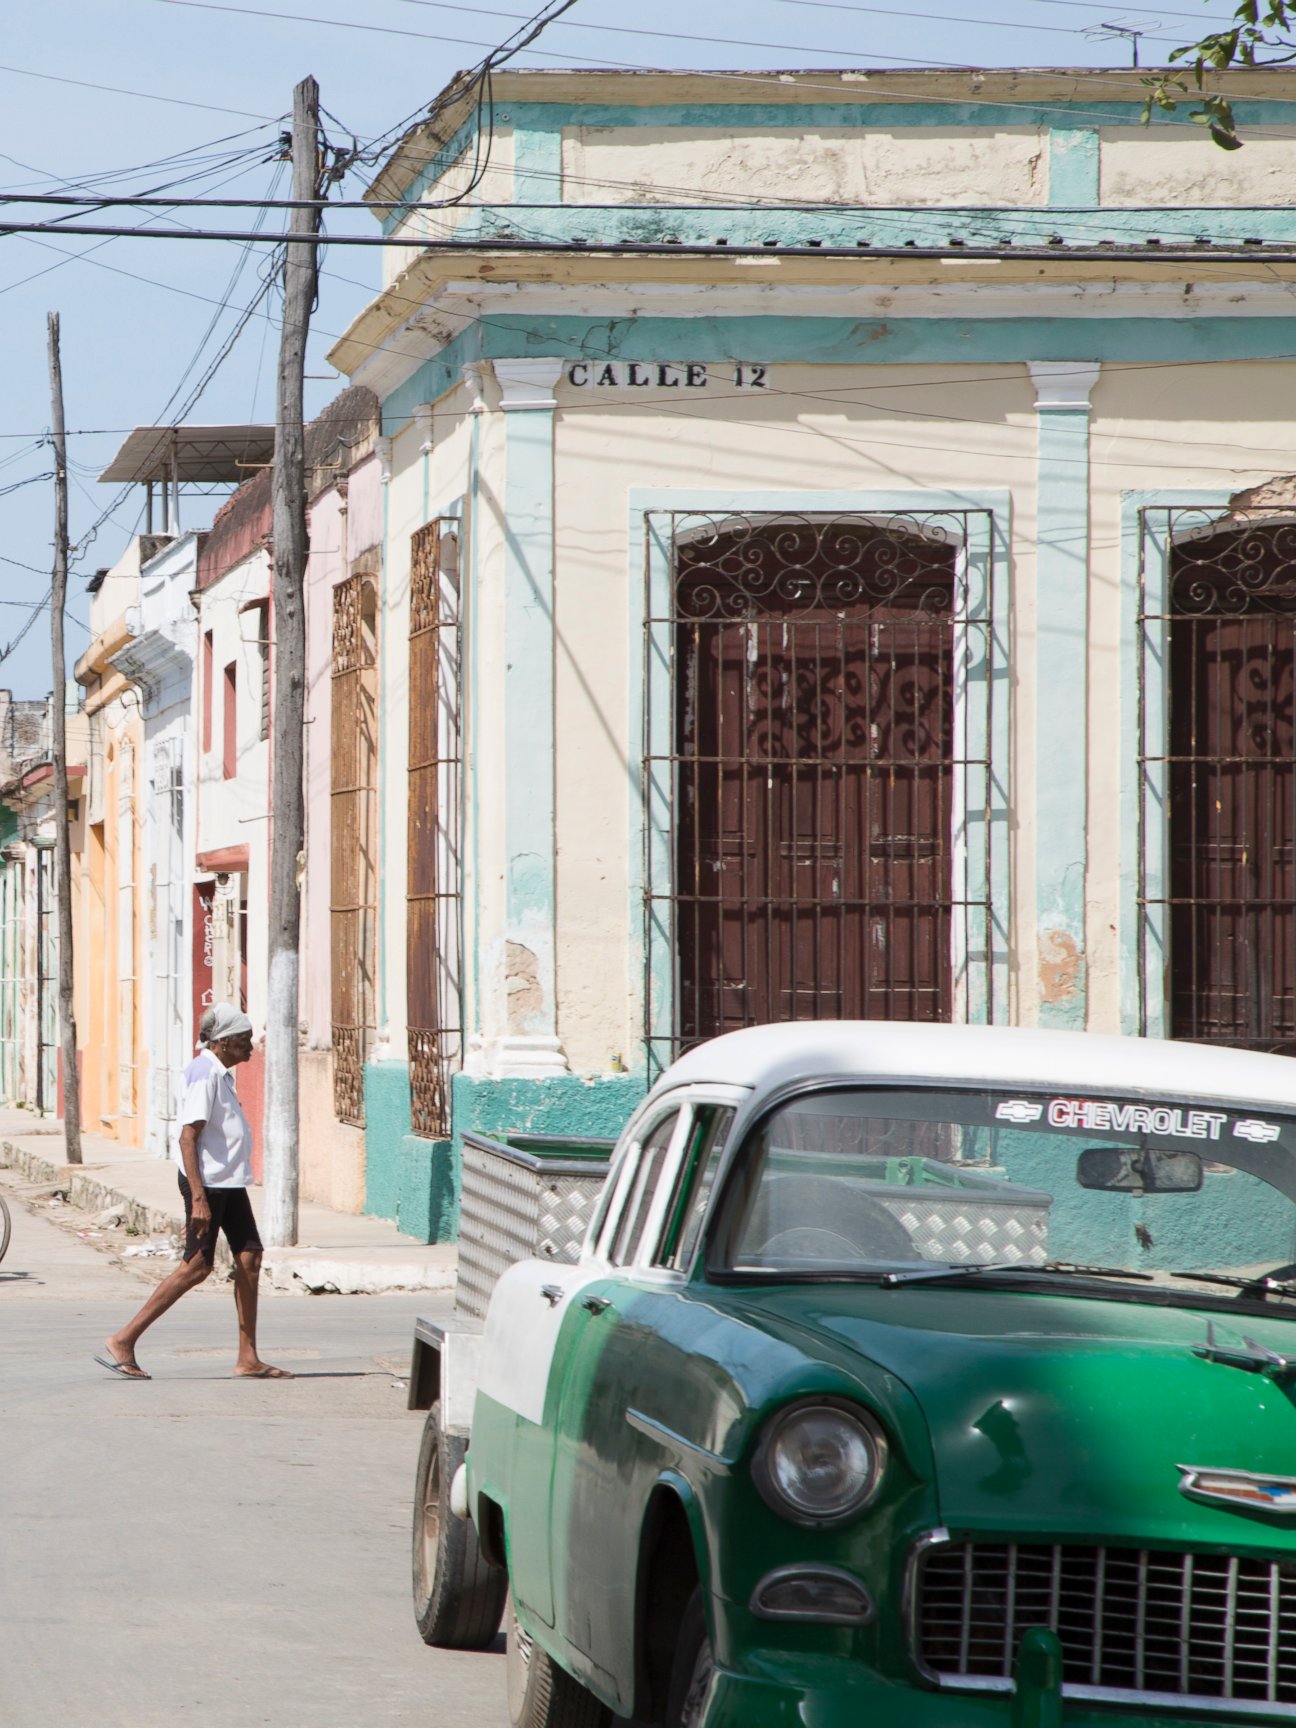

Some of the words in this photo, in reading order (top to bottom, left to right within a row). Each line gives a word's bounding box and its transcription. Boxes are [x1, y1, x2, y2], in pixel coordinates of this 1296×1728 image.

[568, 363, 707, 387] CALLE
[735, 365, 766, 388] 12
[1048, 1099, 1227, 1140] CHEVROLET
